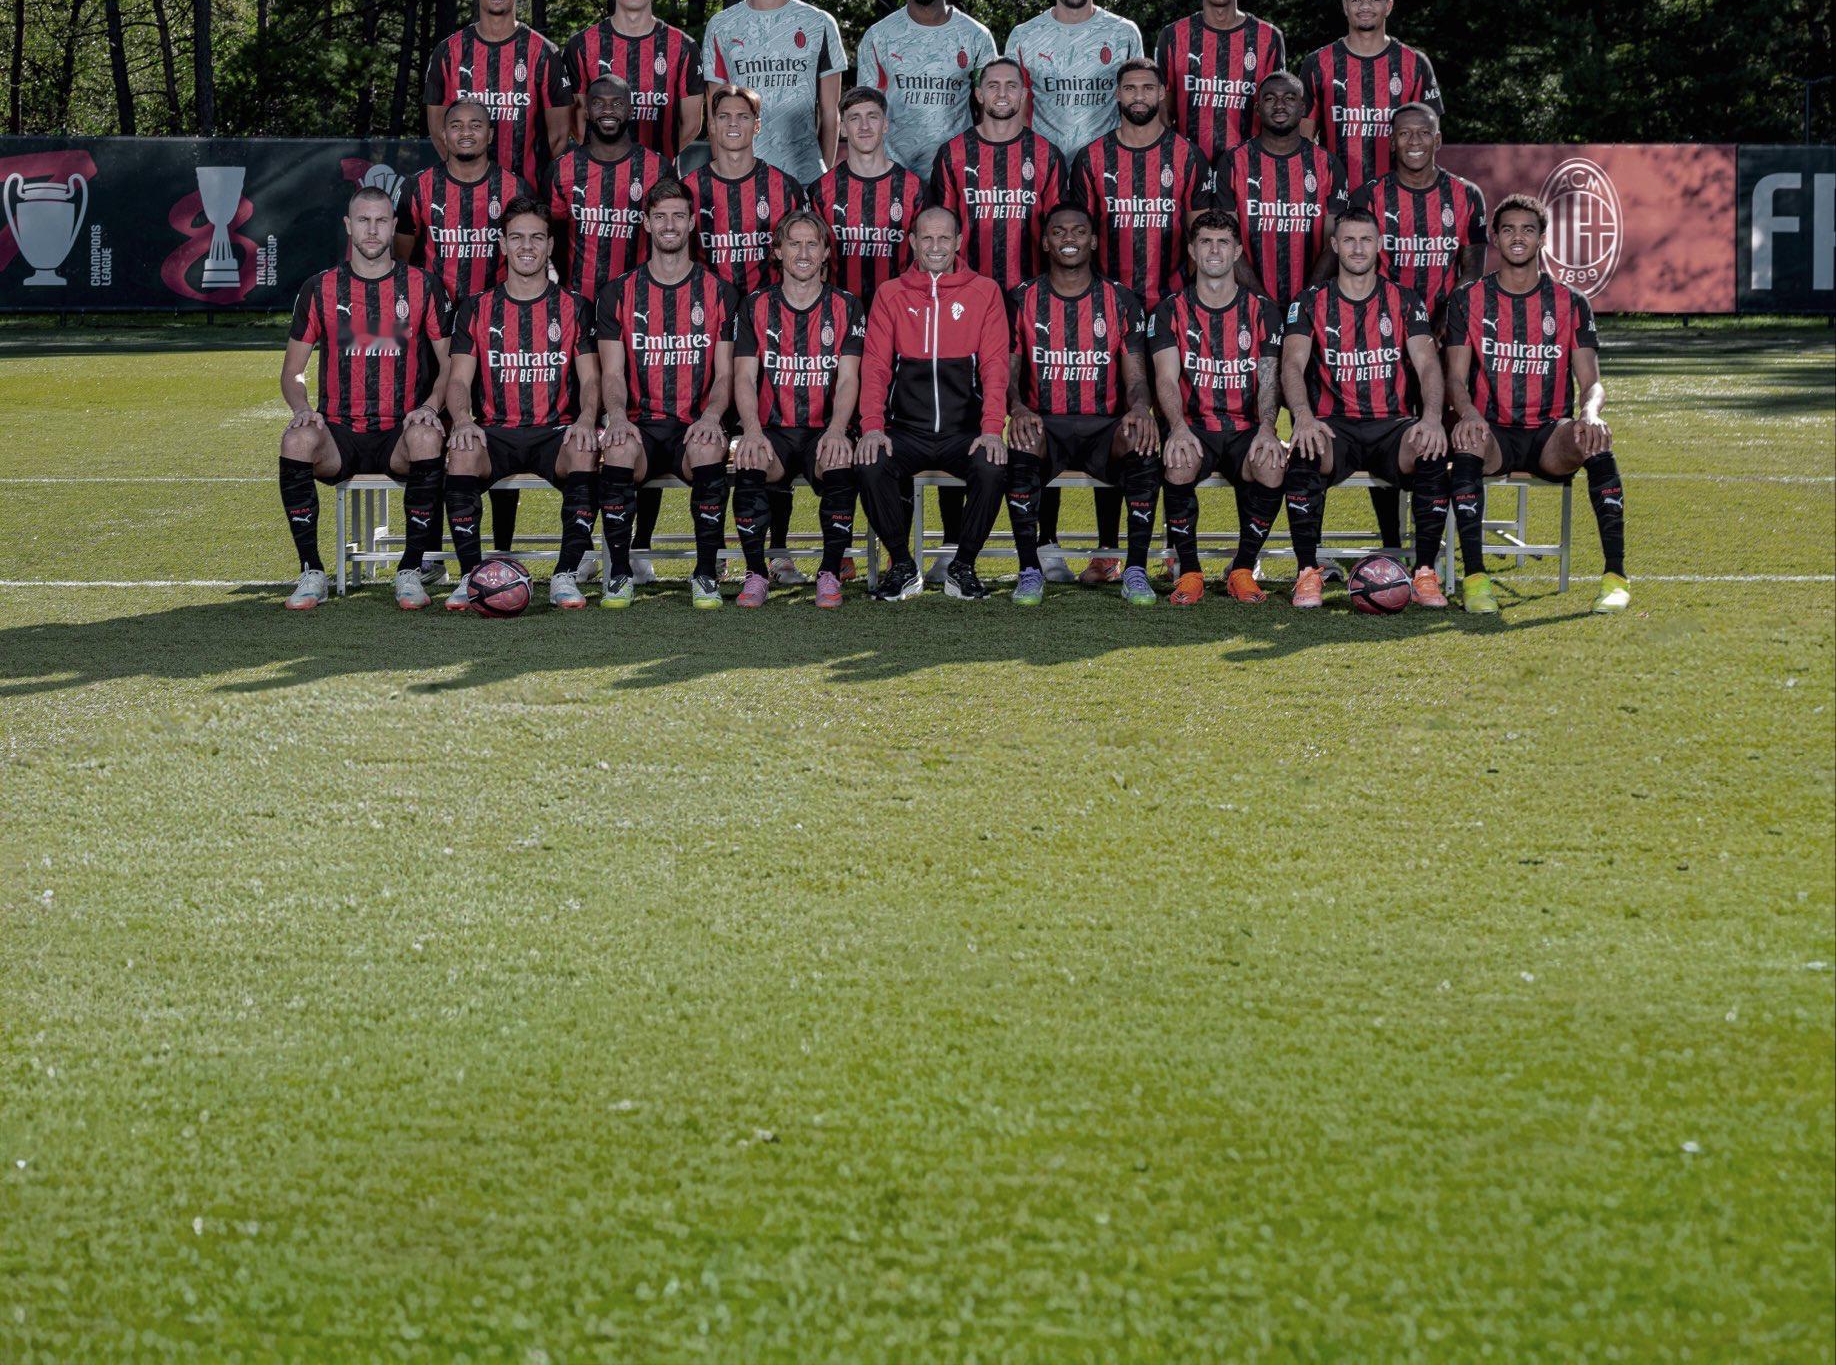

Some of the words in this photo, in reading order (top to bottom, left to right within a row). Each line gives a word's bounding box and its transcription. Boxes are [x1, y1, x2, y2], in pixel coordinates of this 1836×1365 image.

[734, 56, 807, 75] Emirates
[747, 75, 761, 89] FLY
[764, 73, 798, 88] BETTER
[895, 73, 964, 90] Emirates
[1044, 75, 1114, 93] Emirates
[1184, 74, 1256, 95] Emirates
[630, 90, 668, 106] rates
[905, 91, 919, 105] FLY
[923, 91, 956, 106] BETTER
[1055, 93, 1072, 107] FLY
[1074, 93, 1107, 107] BETTER
[1193, 93, 1210, 107] FLY
[1212, 94, 1246, 109] BETTER
[487, 107, 519, 121] ETTER
[1331, 105, 1396, 122] Emirat
[1341, 123, 1359, 137] FLY
[1361, 123, 1393, 137] BETTE
[1555, 169, 1603, 196] ACM
[963, 186, 1037, 205] Emirates
[1104, 195, 1176, 212] Emirates
[570, 203, 645, 224] Emirates
[975, 205, 991, 219] FLY
[992, 205, 1026, 220] BETTER
[1246, 198, 1322, 217] Emirates
[1114, 214, 1130, 228] FLY
[1133, 213, 1168, 228] BETTER
[1257, 218, 1273, 232] FLY
[1276, 218, 1311, 232] BETTER
[580, 220, 596, 234] FLY
[598, 222, 634, 239] BETTER
[832, 223, 905, 243] Emirates
[699, 230, 773, 248] Emirates
[1382, 234, 1459, 251] Emirates
[90, 224, 101, 287] CHAMPIONS
[440, 244, 456, 258] FLY
[458, 244, 494, 258] BETTER
[711, 249, 727, 264] FLY
[730, 247, 765, 262] BETTER
[842, 242, 857, 256] FLY
[859, 242, 893, 258] BETTER
[101, 247, 112, 286] LEAGUE
[256, 247, 266, 285] ITALIAN
[267, 234, 278, 286] SUPERCUP
[1394, 253, 1411, 266] FLY
[1413, 252, 1449, 267] BETTER
[1558, 267, 1599, 284] 1899
[631, 332, 711, 350] Emirates
[1481, 336, 1563, 359] Emirates
[487, 348, 568, 368] Emirates
[643, 352, 661, 366] FLY
[663, 350, 700, 365] BETTER
[763, 350, 839, 369] Emirates
[1032, 346, 1111, 365] Emirates
[1324, 347, 1401, 366] Emirates
[500, 368, 516, 383] FLY
[519, 367, 556, 383] BETTER
[1042, 366, 1059, 381] FLY
[1062, 366, 1099, 381] BETTER
[1336, 368, 1353, 382] FLY
[1355, 365, 1391, 381] BETTER
[1492, 358, 1510, 374] FLY
[1511, 359, 1550, 375] BETTER
[774, 371, 791, 386] FLY
[793, 371, 829, 386] BETTER
[1193, 372, 1210, 387] FLY
[1212, 374, 1247, 389] BETTER
